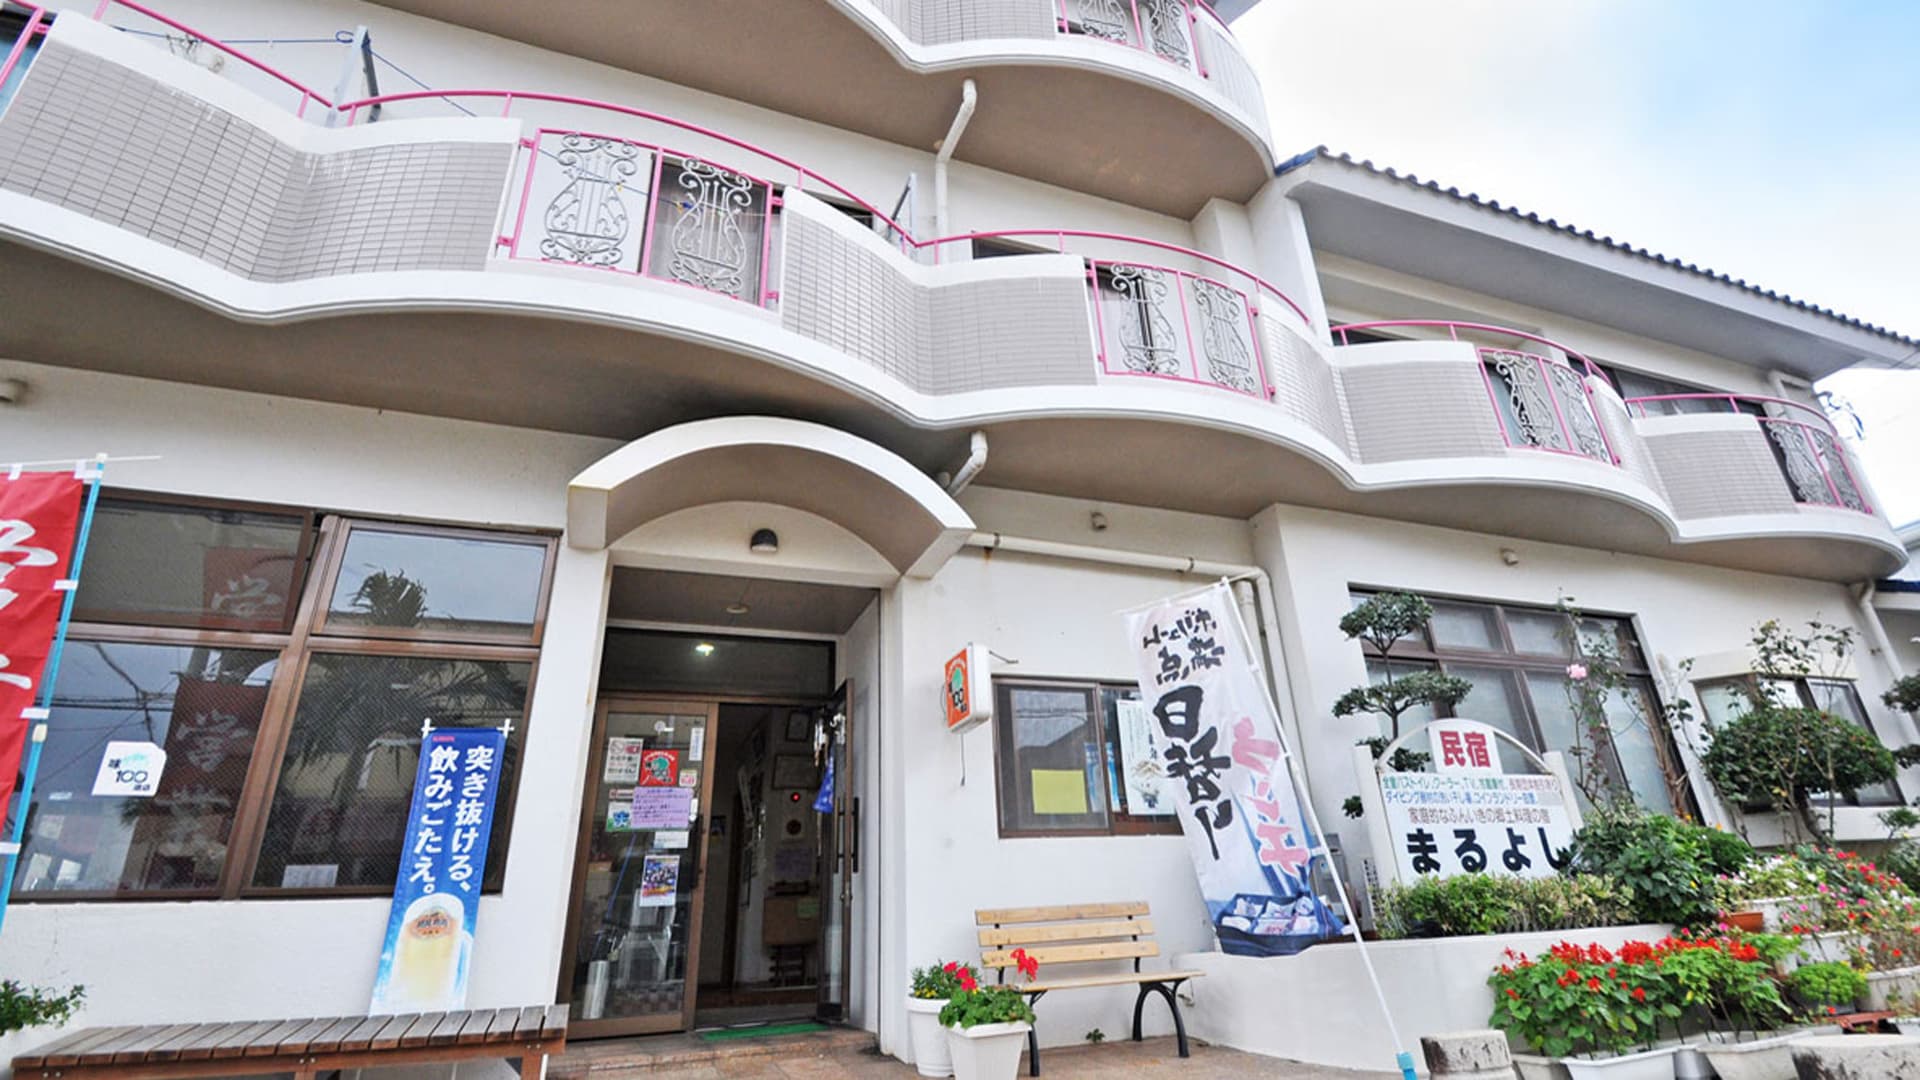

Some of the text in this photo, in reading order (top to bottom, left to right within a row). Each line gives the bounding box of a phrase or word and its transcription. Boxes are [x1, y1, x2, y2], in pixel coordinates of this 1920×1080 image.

[1439, 731, 1491, 768] 民宿
[115, 769, 149, 784] 100
[409, 745, 461, 894] 飲みごたえ。
[447, 745, 494, 893] 突き抜ける、
[1406, 827, 1563, 874] まるよし
